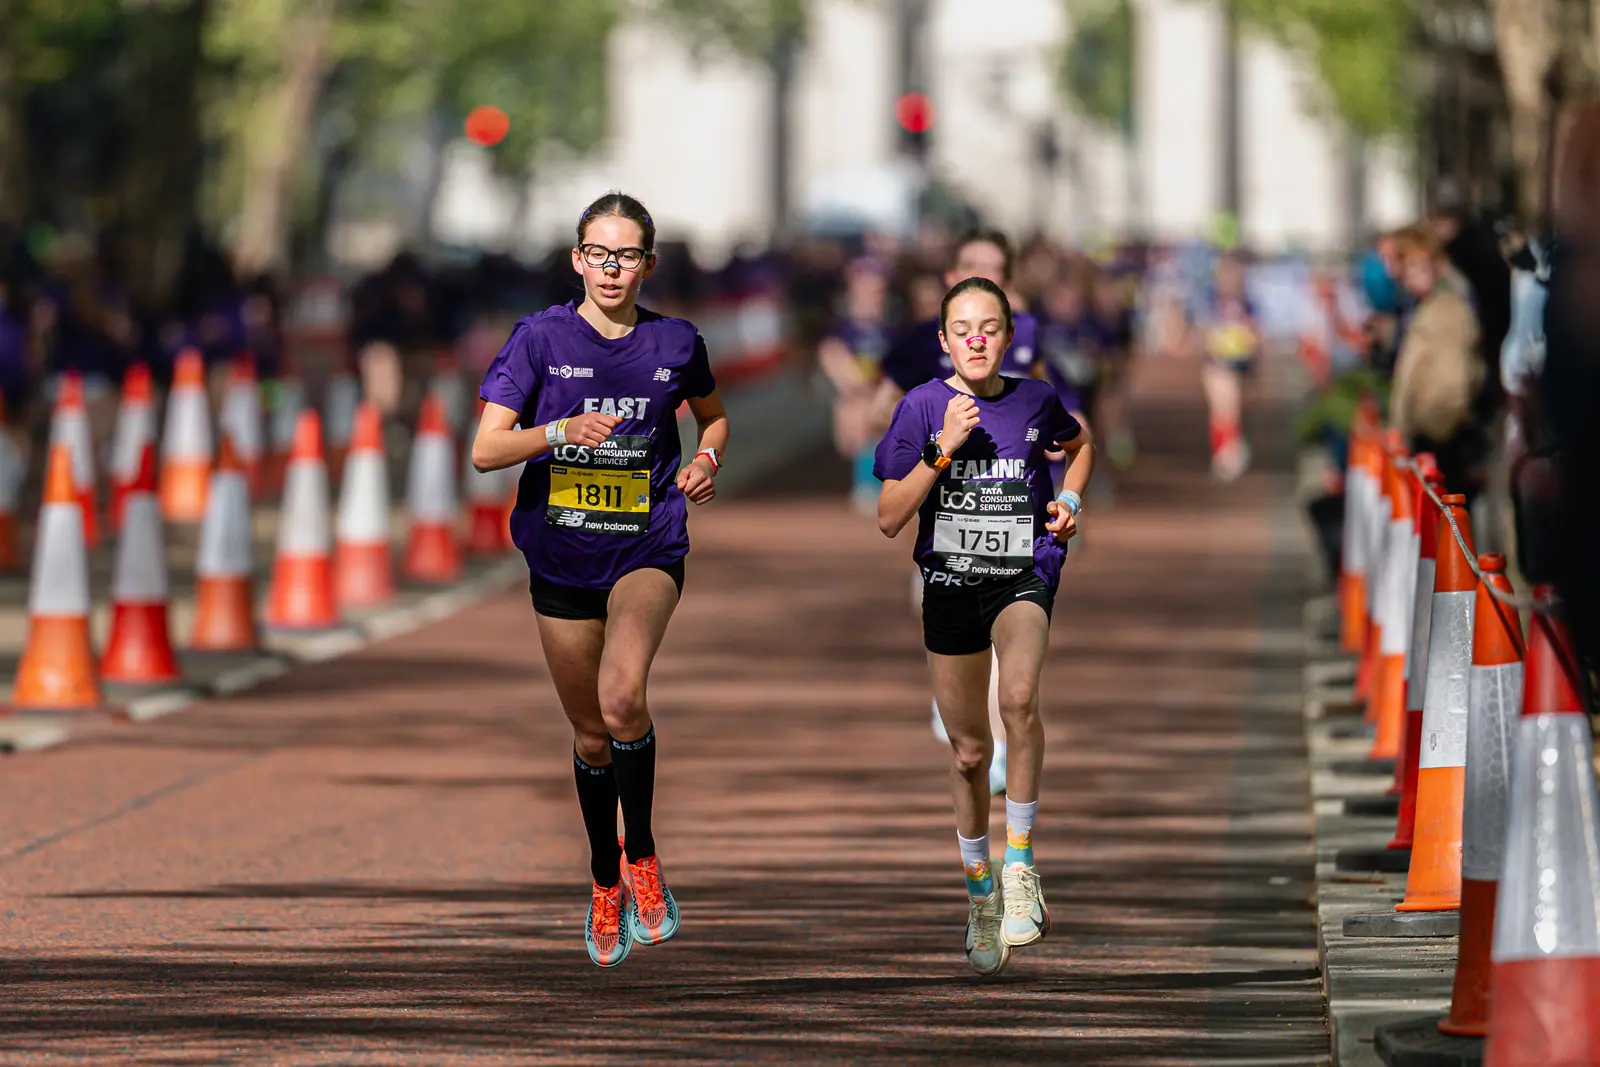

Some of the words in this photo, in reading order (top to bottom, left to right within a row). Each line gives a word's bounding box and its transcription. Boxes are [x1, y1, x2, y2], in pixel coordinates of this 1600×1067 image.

[584, 397, 650, 420] EAST
[597, 440, 618, 449] ATA
[593, 448, 647, 458] CONSULTANCY
[593, 457, 628, 466] SERVICES
[950, 459, 1025, 479] EALING
[575, 483, 622, 508] 1811
[980, 487, 1003, 495] TATA
[940, 485, 976, 511] tcs
[980, 495, 1028, 503] CONSULTANCY
[979, 503, 1013, 511] SERVICES
[585, 521, 603, 530] new
[603, 521, 640, 532] balance
[958, 528, 1010, 553] 1751
[971, 566, 990, 574] new
